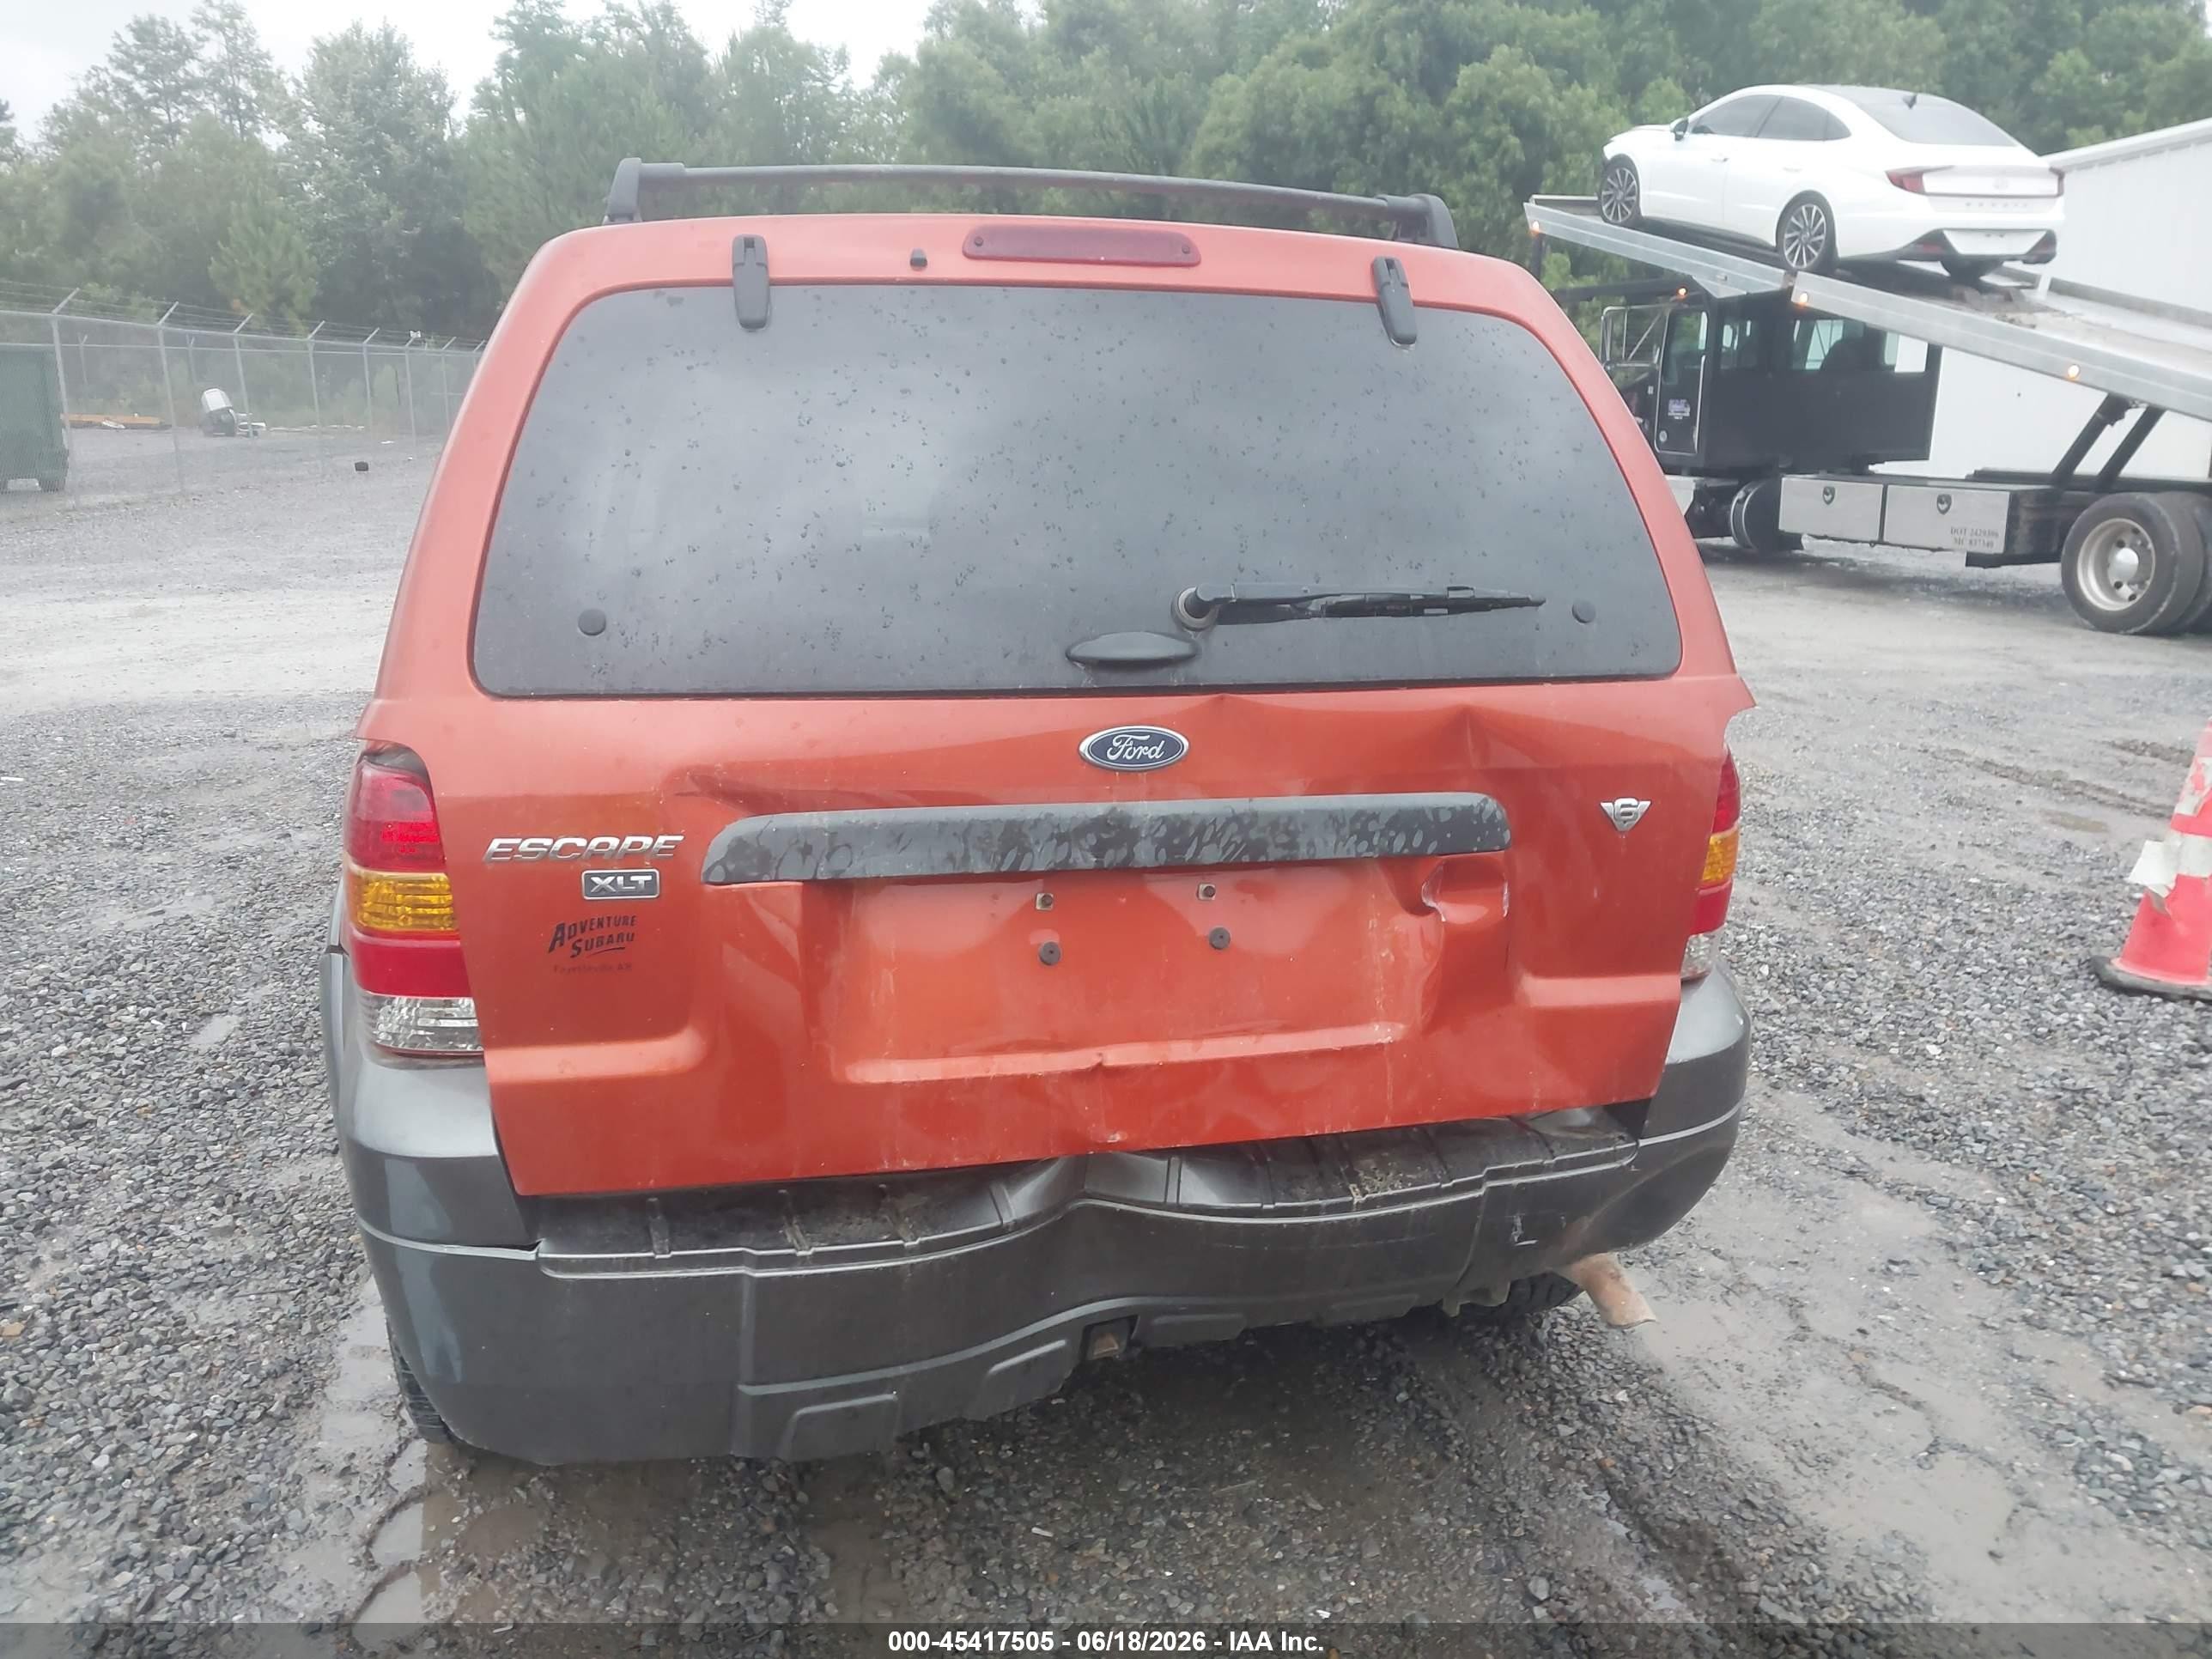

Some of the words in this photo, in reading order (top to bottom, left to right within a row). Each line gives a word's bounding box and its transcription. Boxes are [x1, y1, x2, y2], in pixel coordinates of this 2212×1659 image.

[1106, 734, 1165, 760] Ford
[483, 835, 685, 861] ESCAPE
[589, 874, 653, 893] XLT
[548, 915, 637, 953] ADVENTURE
[569, 932, 635, 958] SUBARU
